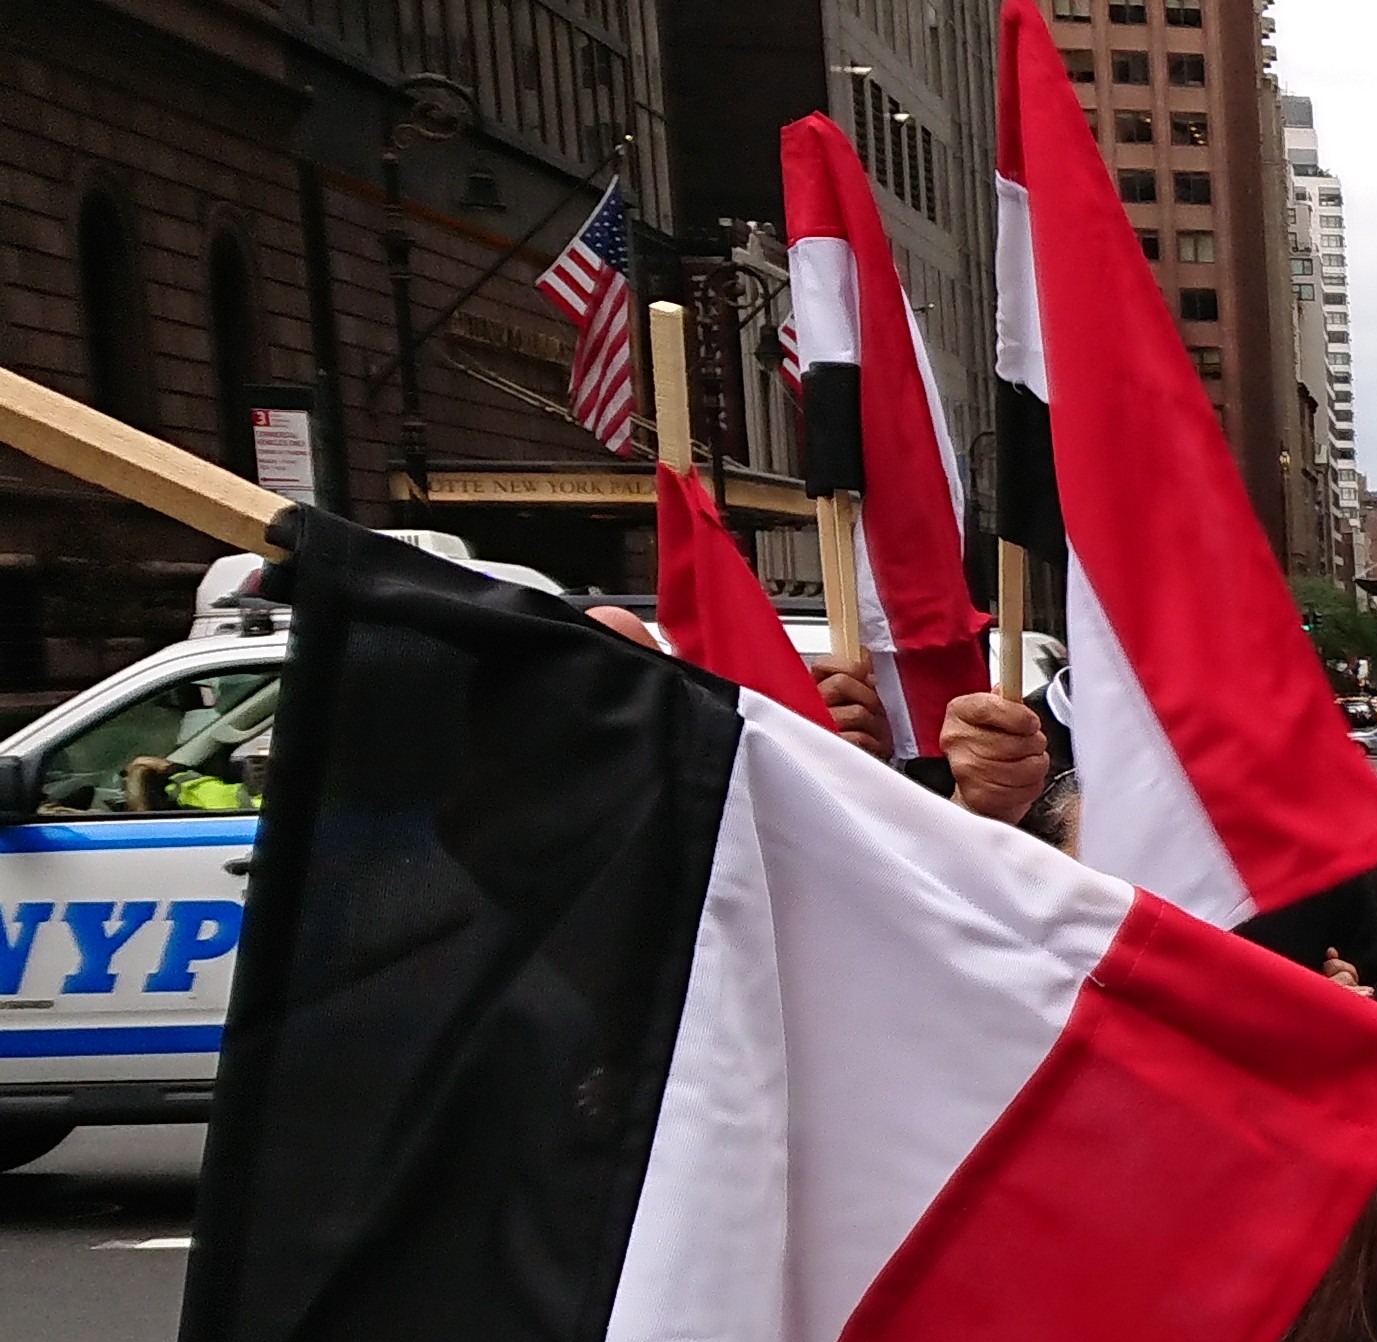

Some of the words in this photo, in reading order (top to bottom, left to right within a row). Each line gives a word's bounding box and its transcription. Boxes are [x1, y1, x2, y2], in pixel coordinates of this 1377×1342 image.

[255, 410, 267, 426] 3
[427, 478, 483, 494] OTTE
[492, 480, 541, 495] NEW
[549, 480, 602, 495] YORK
[610, 480, 656, 495] PAL
[0, 899, 244, 996] NYP
